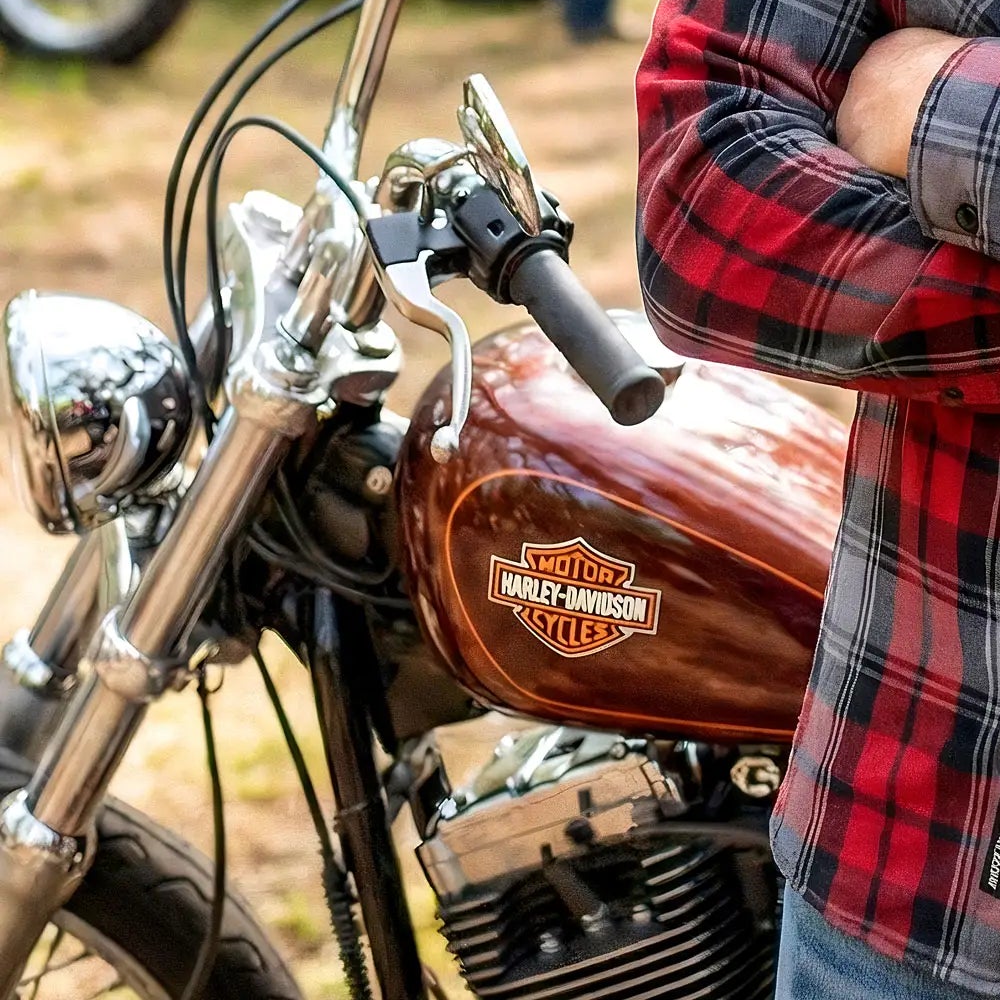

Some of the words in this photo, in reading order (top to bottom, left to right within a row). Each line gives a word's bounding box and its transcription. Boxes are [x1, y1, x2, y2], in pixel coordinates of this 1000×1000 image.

[539, 552, 615, 584] MOTOR
[501, 571, 647, 622] HARLEY-DAVIDSON
[532, 611, 609, 647] CYCLES
